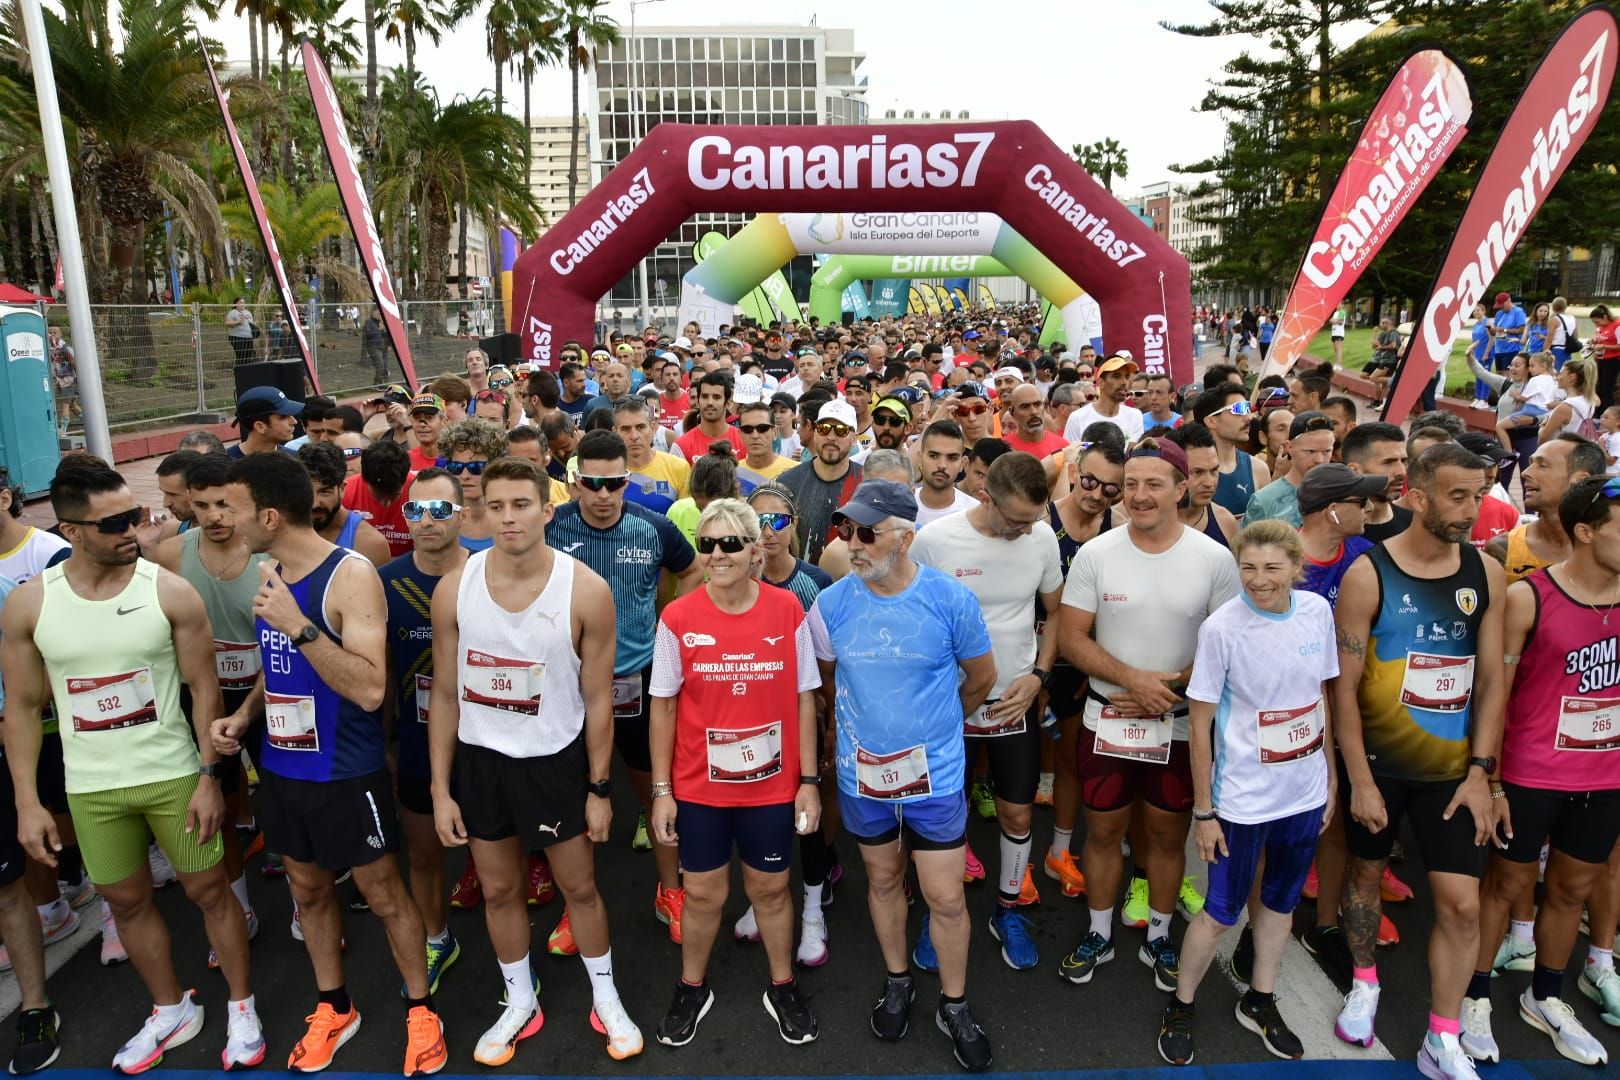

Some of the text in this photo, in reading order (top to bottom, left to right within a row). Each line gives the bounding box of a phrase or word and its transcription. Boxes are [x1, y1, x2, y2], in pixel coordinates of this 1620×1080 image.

[687, 132, 996, 190] Canarias7
[1302, 71, 1453, 288] Canarias7
[1350, 118, 1461, 270] Toda la información de Canarias
[1423, 29, 1608, 363] Canarias7
[549, 166, 656, 275] Canarias7
[852, 212, 979, 228] Gran Canaria
[1024, 164, 1147, 267] Canarias7
[850, 228, 980, 241] Isla Europea del Deporte
[891, 255, 982, 273] Binter
[617, 545, 651, 558] civitas
[721, 653, 755, 661] Canarias7
[220, 660, 244, 672] 1797
[692, 661, 784, 672] CARRERA DE LAS EMPRESAS
[491, 678, 512, 691] 394
[1436, 678, 1456, 691] 297
[97, 695, 122, 712] 532
[1592, 718, 1612, 732] 265
[1123, 728, 1146, 740] 1807
[1288, 724, 1310, 743] 1795
[742, 749, 754, 763] 16
[880, 770, 899, 785] 137
